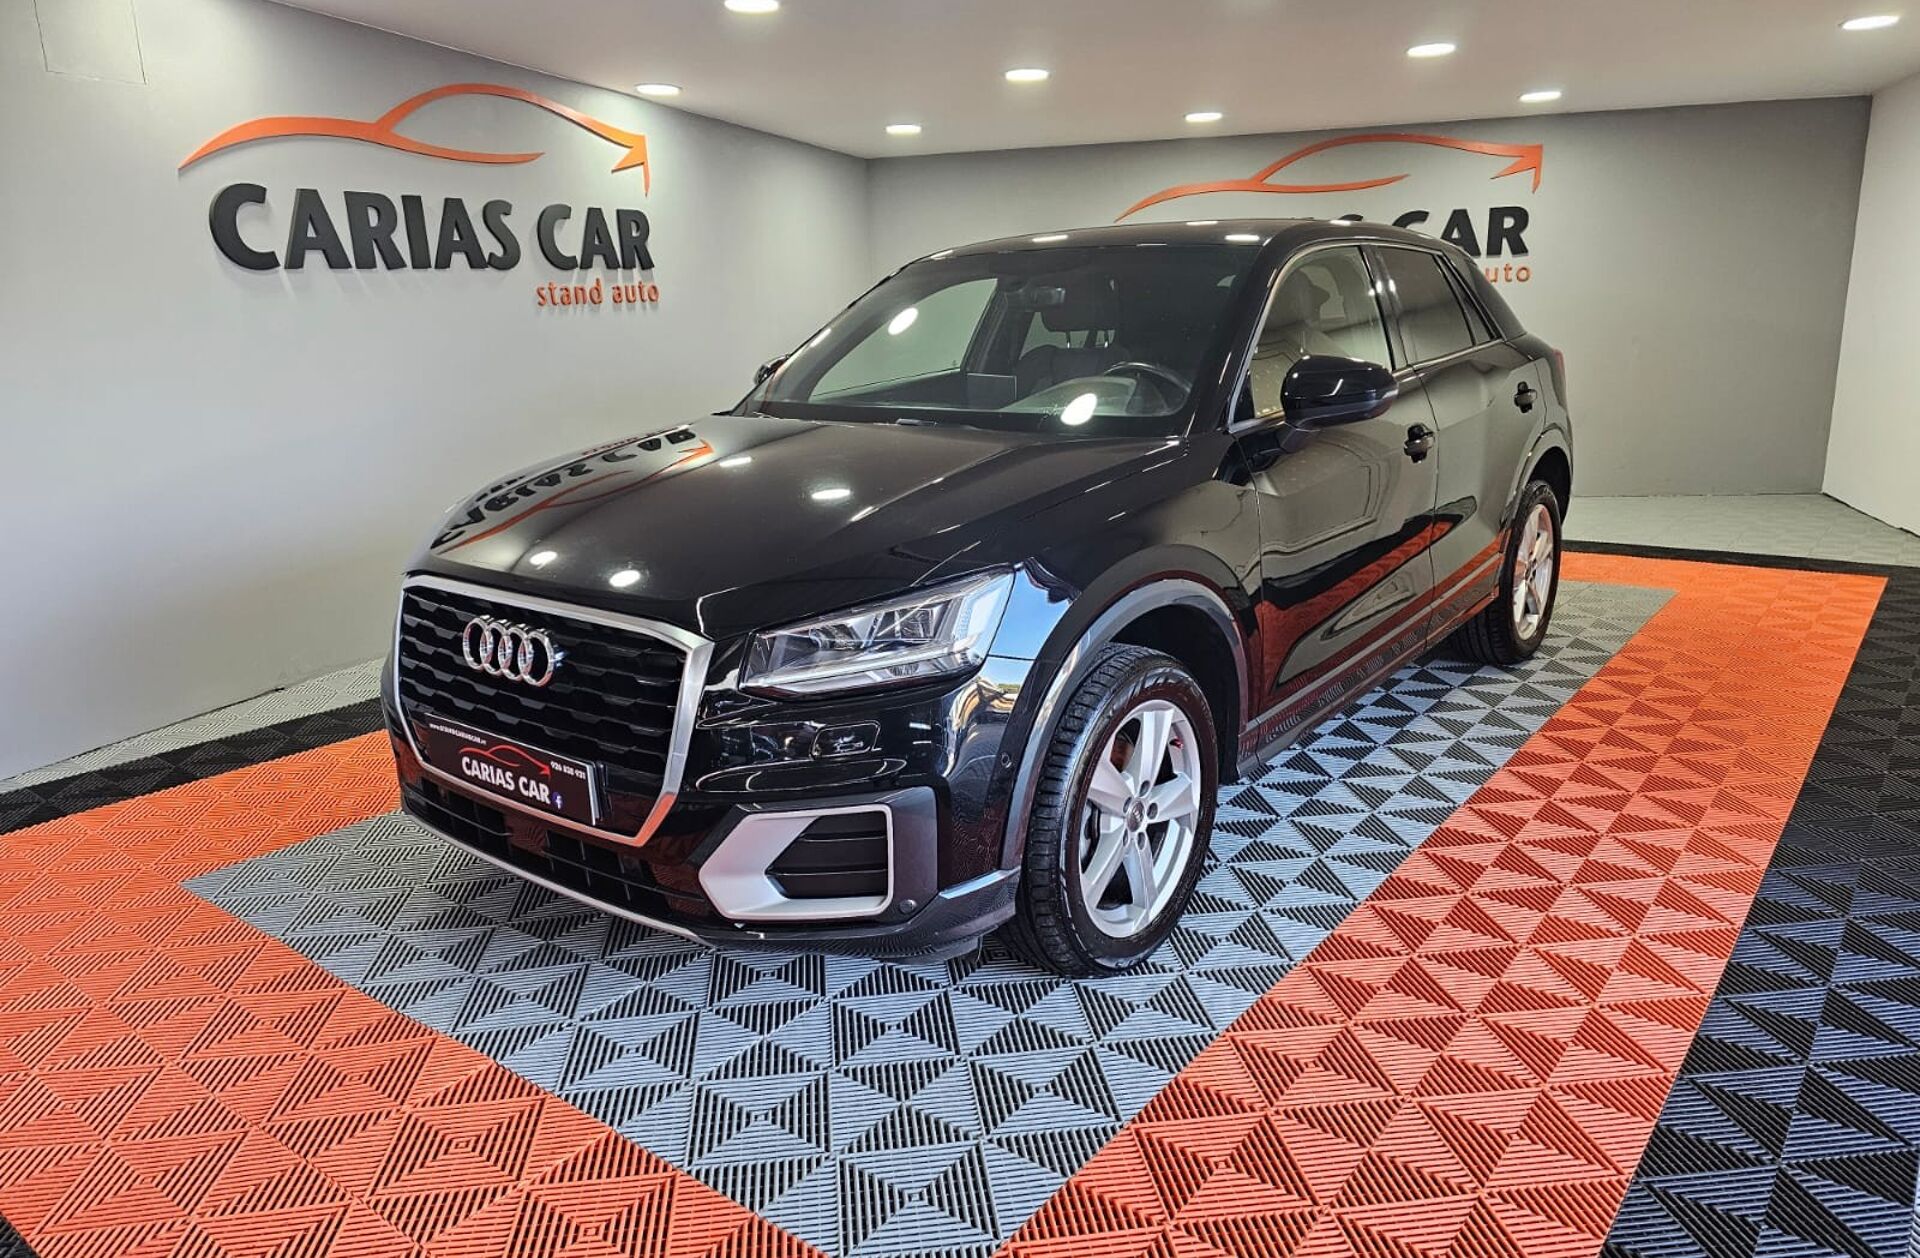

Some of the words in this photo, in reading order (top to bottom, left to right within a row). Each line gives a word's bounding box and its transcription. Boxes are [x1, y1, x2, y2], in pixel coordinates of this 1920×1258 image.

[209, 182, 521, 271] CARIAS
[537, 203, 654, 271] CAR
[1392, 206, 1530, 257] AR
[536, 278, 603, 307] stand
[612, 280, 660, 306] auto
[1485, 263, 1531, 283] uto
[461, 756, 515, 791] CARIAS
[518, 776, 551, 804] CAR
